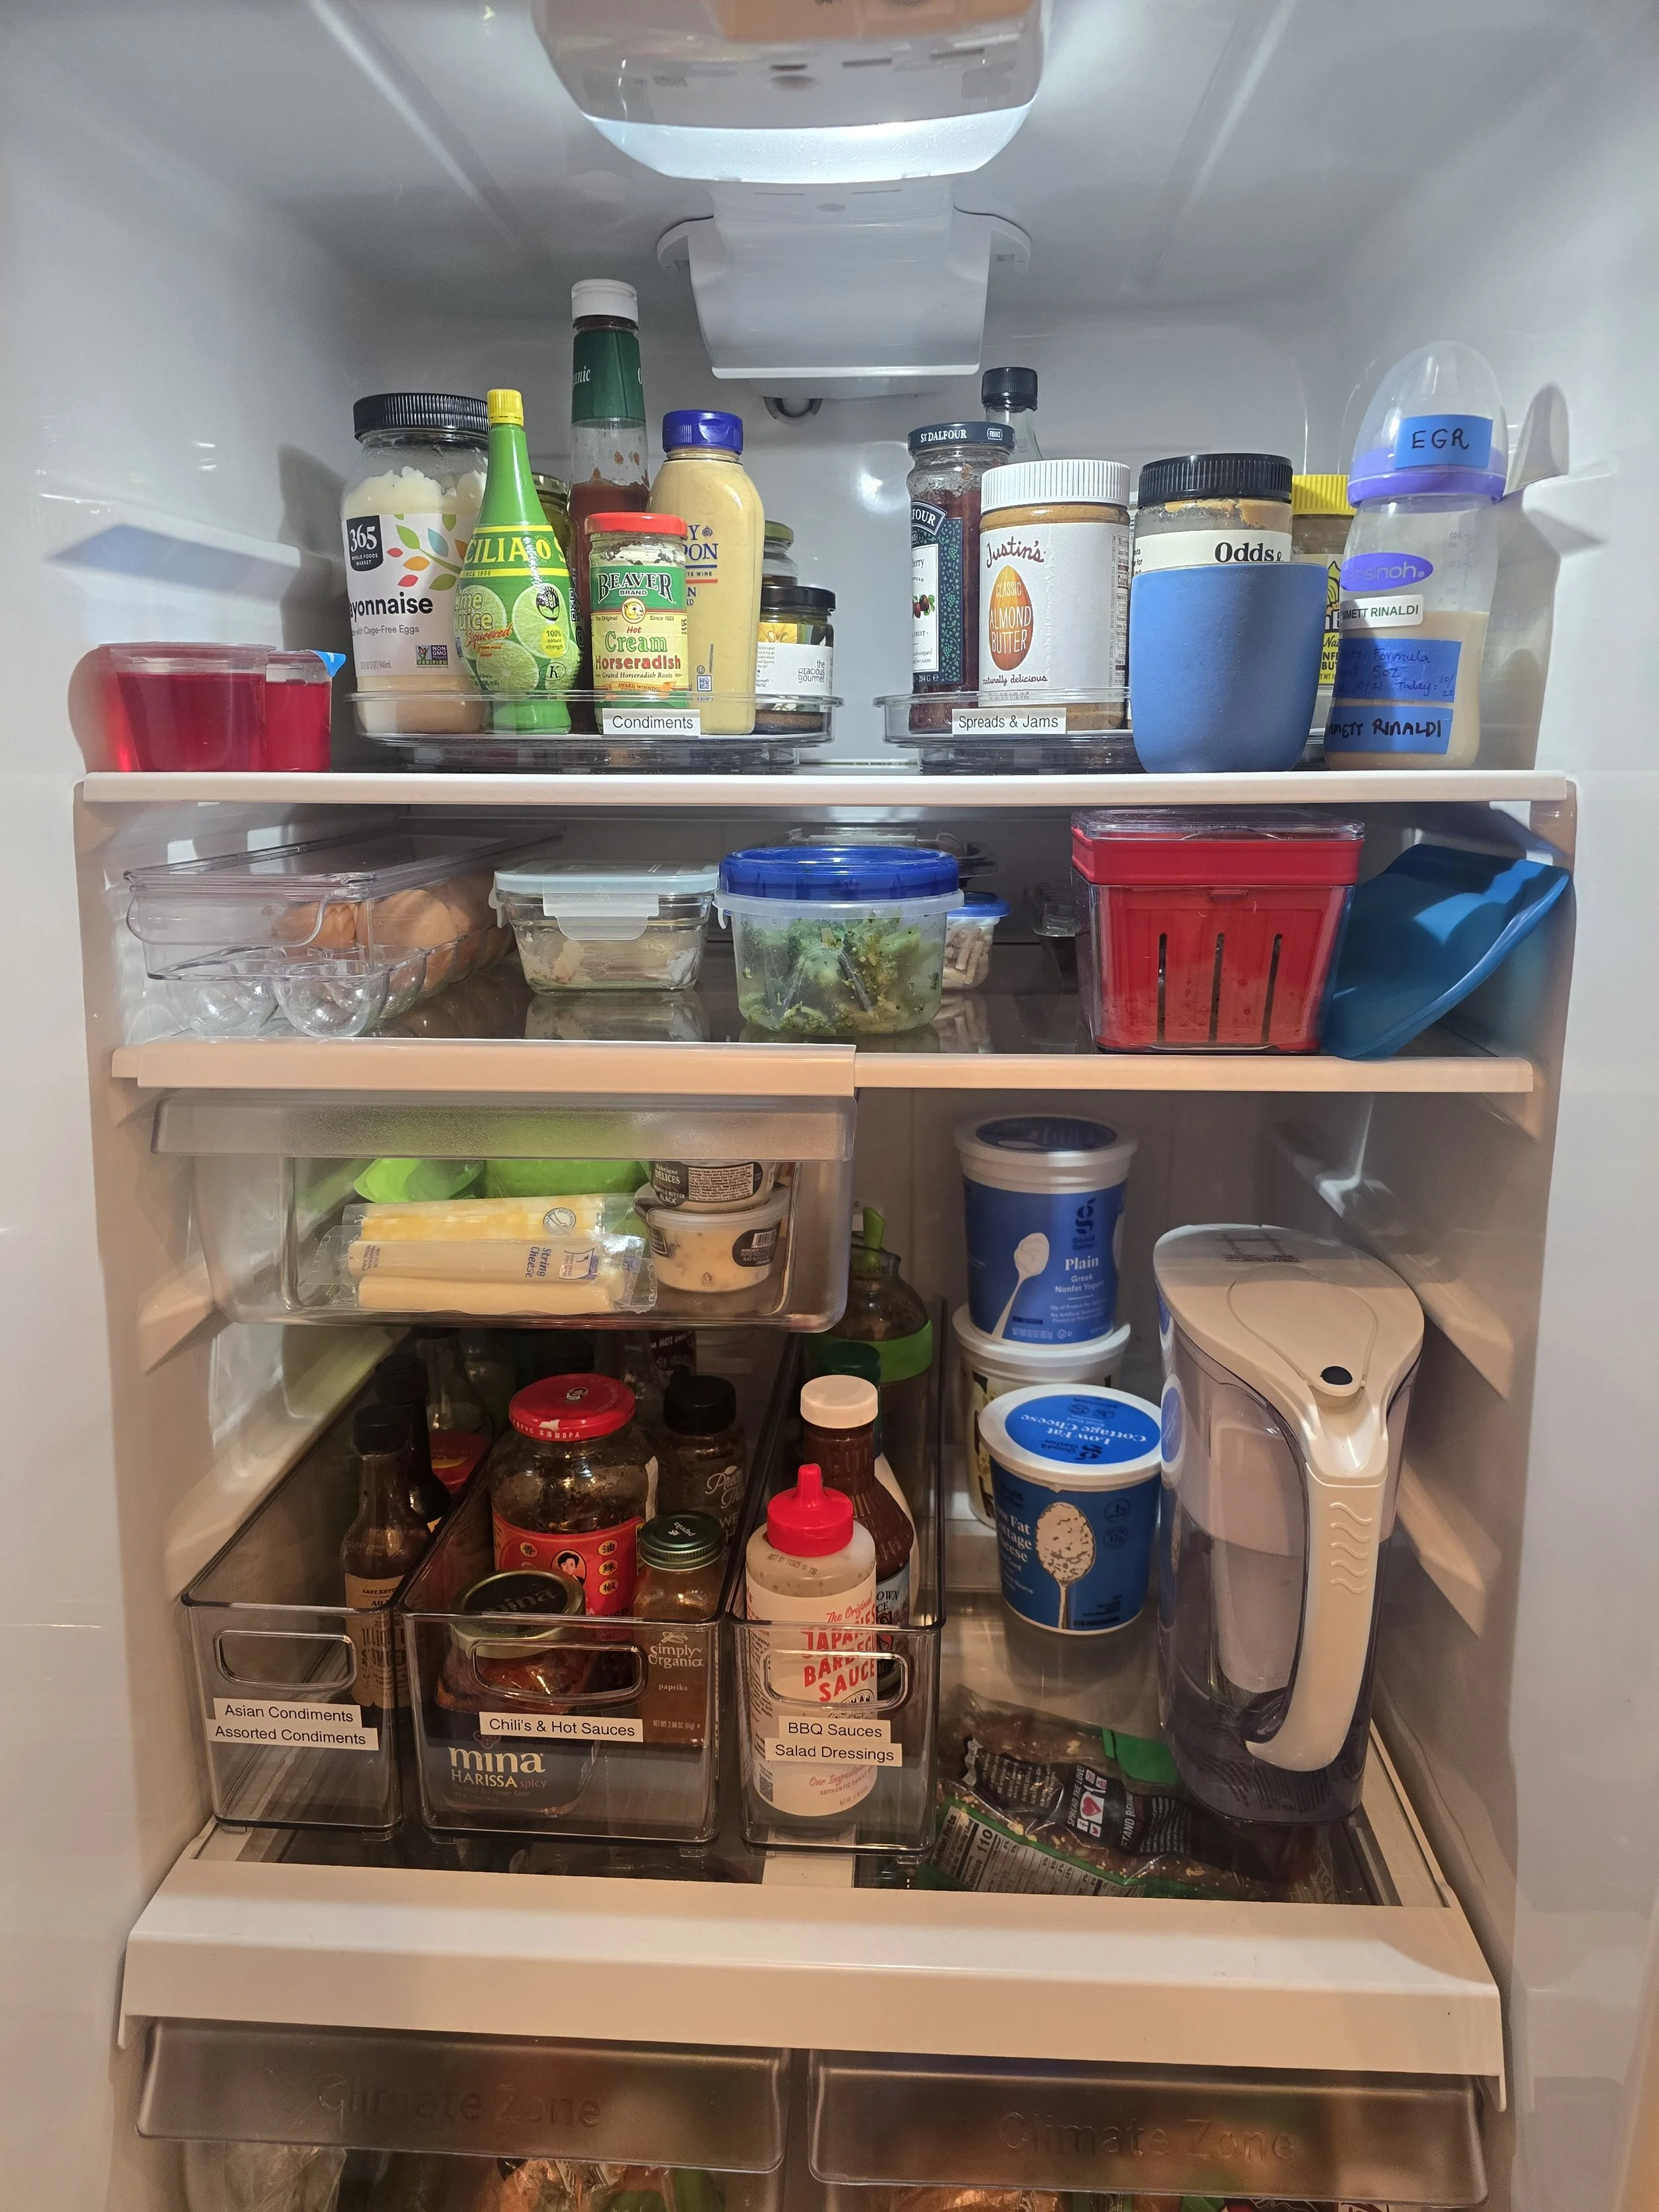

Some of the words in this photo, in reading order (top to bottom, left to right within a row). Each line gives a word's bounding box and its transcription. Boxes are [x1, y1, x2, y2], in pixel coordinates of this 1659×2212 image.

[928, 429, 968, 442] DALFOUR
[1411, 428, 1471, 451] EGR
[350, 524, 378, 552] 365
[986, 536, 1044, 569] Justin's
[1214, 542, 1274, 563] Odds
[597, 572, 674, 605] BEAVER
[995, 581, 1023, 598] CLASSIC
[989, 605, 1031, 630] ALMOND
[1370, 605, 1419, 618] RINALDI
[364, 625, 397, 636] Cage-Free
[399, 625, 420, 634] Eggs
[465, 624, 513, 648] Squeezed
[605, 631, 668, 653] Cream
[991, 629, 1027, 654] BUTTER
[595, 655, 682, 670] Horseradish
[816, 659, 826, 669] the
[1372, 648, 1431, 663] Formula
[798, 666, 826, 678] gracious
[798, 674, 825, 684] gourmet
[982, 674, 1008, 687] naturally
[1010, 674, 1048, 684] delicious
[612, 715, 693, 730] Condiments
[958, 715, 1005, 729] Spreads
[1009, 715, 1019, 728] &
[1023, 715, 1058, 728] Jams
[656, 1163, 678, 1175] Fabrique
[660, 1193, 677, 1205] BLACK
[525, 1246, 540, 1278] Cheese
[536, 1247, 552, 1278] String
[1064, 1255, 1100, 1271] Plain
[1054, 1283, 1082, 1293] Nonfat
[1083, 1280, 1104, 1291] Yogurt
[1070, 1273, 1094, 1283] Greek
[1020, 1414, 1078, 1432] Cheese
[1046, 1427, 1073, 1439] Fat
[1075, 1432, 1111, 1445] Low
[1080, 1425, 1147, 1443] Cottage
[1009, 1514, 1031, 1536] Fat
[523, 1544, 536, 1556] 香
[826, 1611, 843, 1623] The
[845, 1589, 873, 1619] Original
[650, 1643, 703, 1658] Simply
[648, 1654, 705, 1669] Organic
[658, 1684, 688, 1692] paprika
[819, 1657, 875, 1702] SAUCE
[225, 1704, 264, 1718] Asian
[268, 1706, 354, 1722] Condiments
[215, 1726, 277, 1740] Assorted
[281, 1728, 366, 1745] Condiments
[489, 1718, 532, 1732] Chili's
[537, 1720, 547, 1733] &
[551, 1721, 577, 1734] Hot
[581, 1724, 635, 1737] Sauces
[788, 1722, 823, 1735] BBQ
[828, 1724, 883, 1737] Sauces
[448, 1746, 546, 1774] mina
[775, 1744, 816, 1757] Salad
[822, 1746, 895, 1763] Dressings
[451, 1768, 518, 1788] HARISSA
[520, 1779, 547, 1789] spicy
[808, 1776, 826, 1787] Our
[820, 1783, 851, 1796] AUTHENTIC
[1072, 1785, 1082, 1800] THE
[1066, 1797, 1080, 1827] SPREAD
[1120, 1817, 1136, 1848] STAND
[966, 1858, 983, 1889] Calories
[977, 1828, 993, 1853] 110
[318, 2073, 482, 2122] Climate
[495, 2083, 601, 2128] Zone
[999, 2111, 1171, 2156] Climate
[1185, 2118, 1299, 2162] Zone
